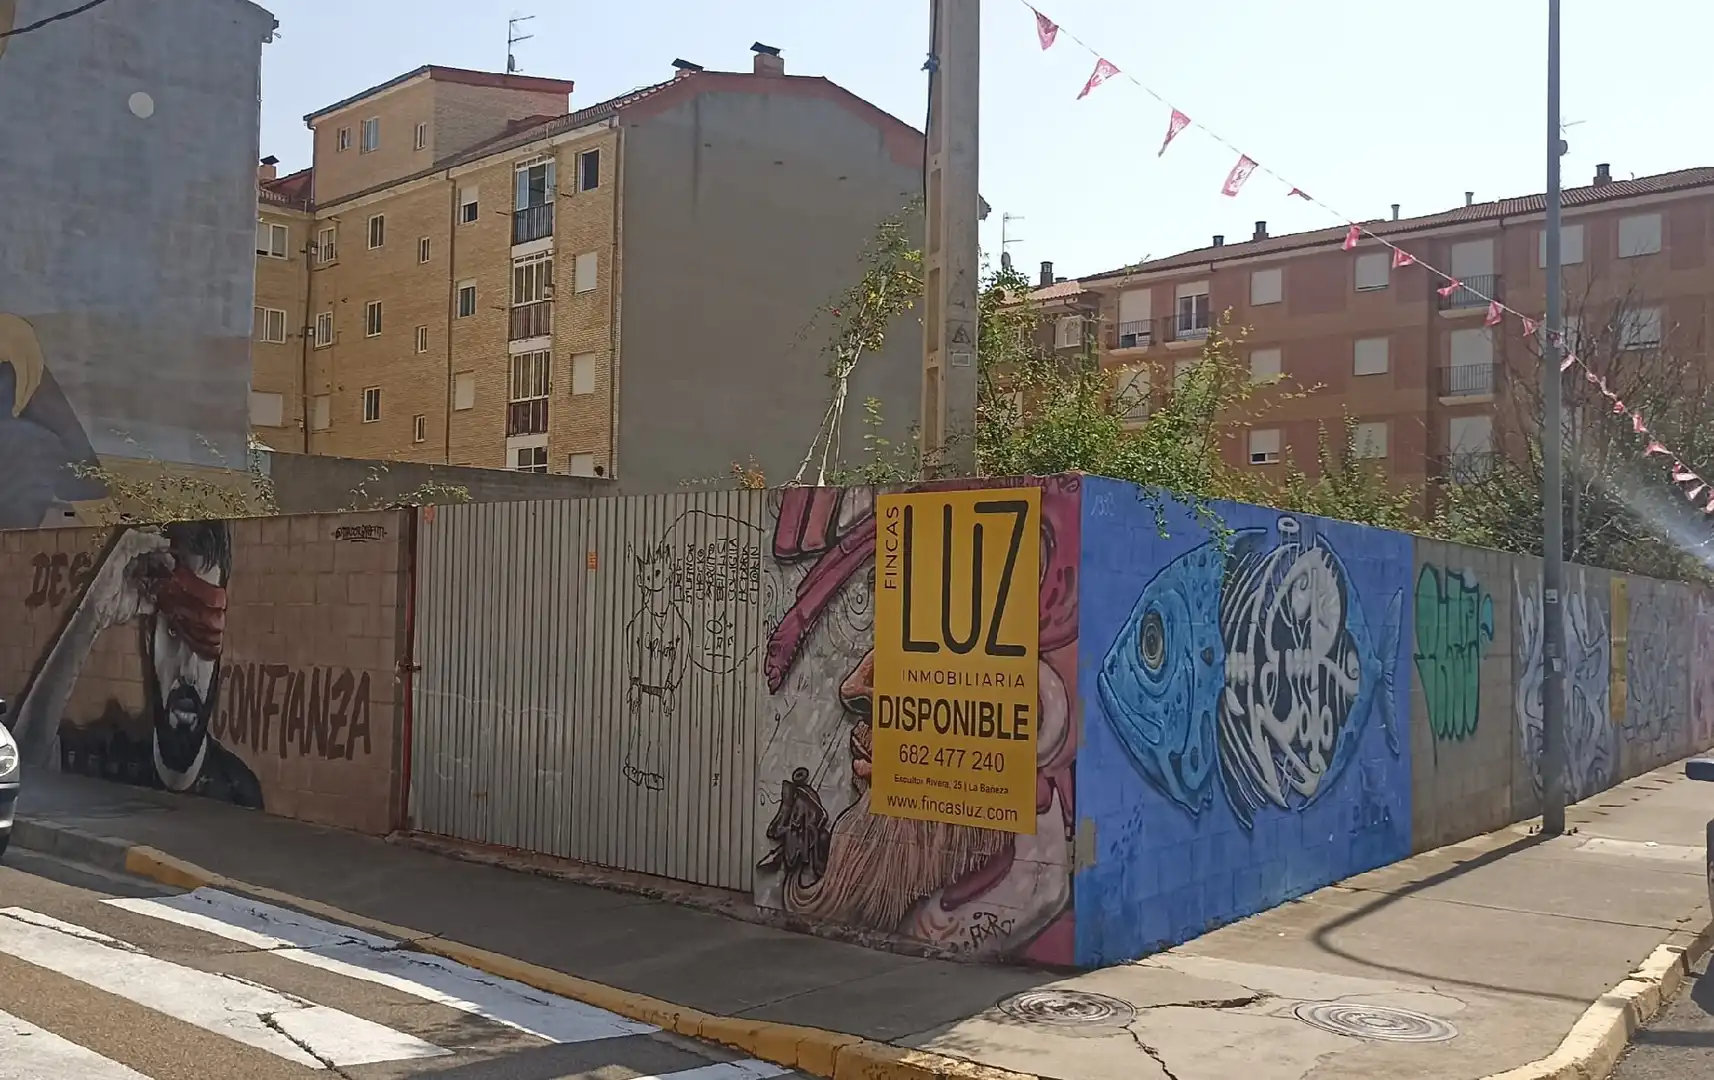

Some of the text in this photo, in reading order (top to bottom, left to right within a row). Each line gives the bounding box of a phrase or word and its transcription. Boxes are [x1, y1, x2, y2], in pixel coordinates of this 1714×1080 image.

[884, 506, 899, 590] FINCAS
[903, 500, 1028, 657] LUZ
[902, 669, 1025, 688] INMOBILIARIA
[209, 663, 372, 760] CONFIANZA
[878, 695, 1029, 741] DISPONIBLE
[899, 744, 1005, 773] 682 477 240
[969, 783, 978, 792] La
[887, 795, 1018, 822] www.fincasluz.com
